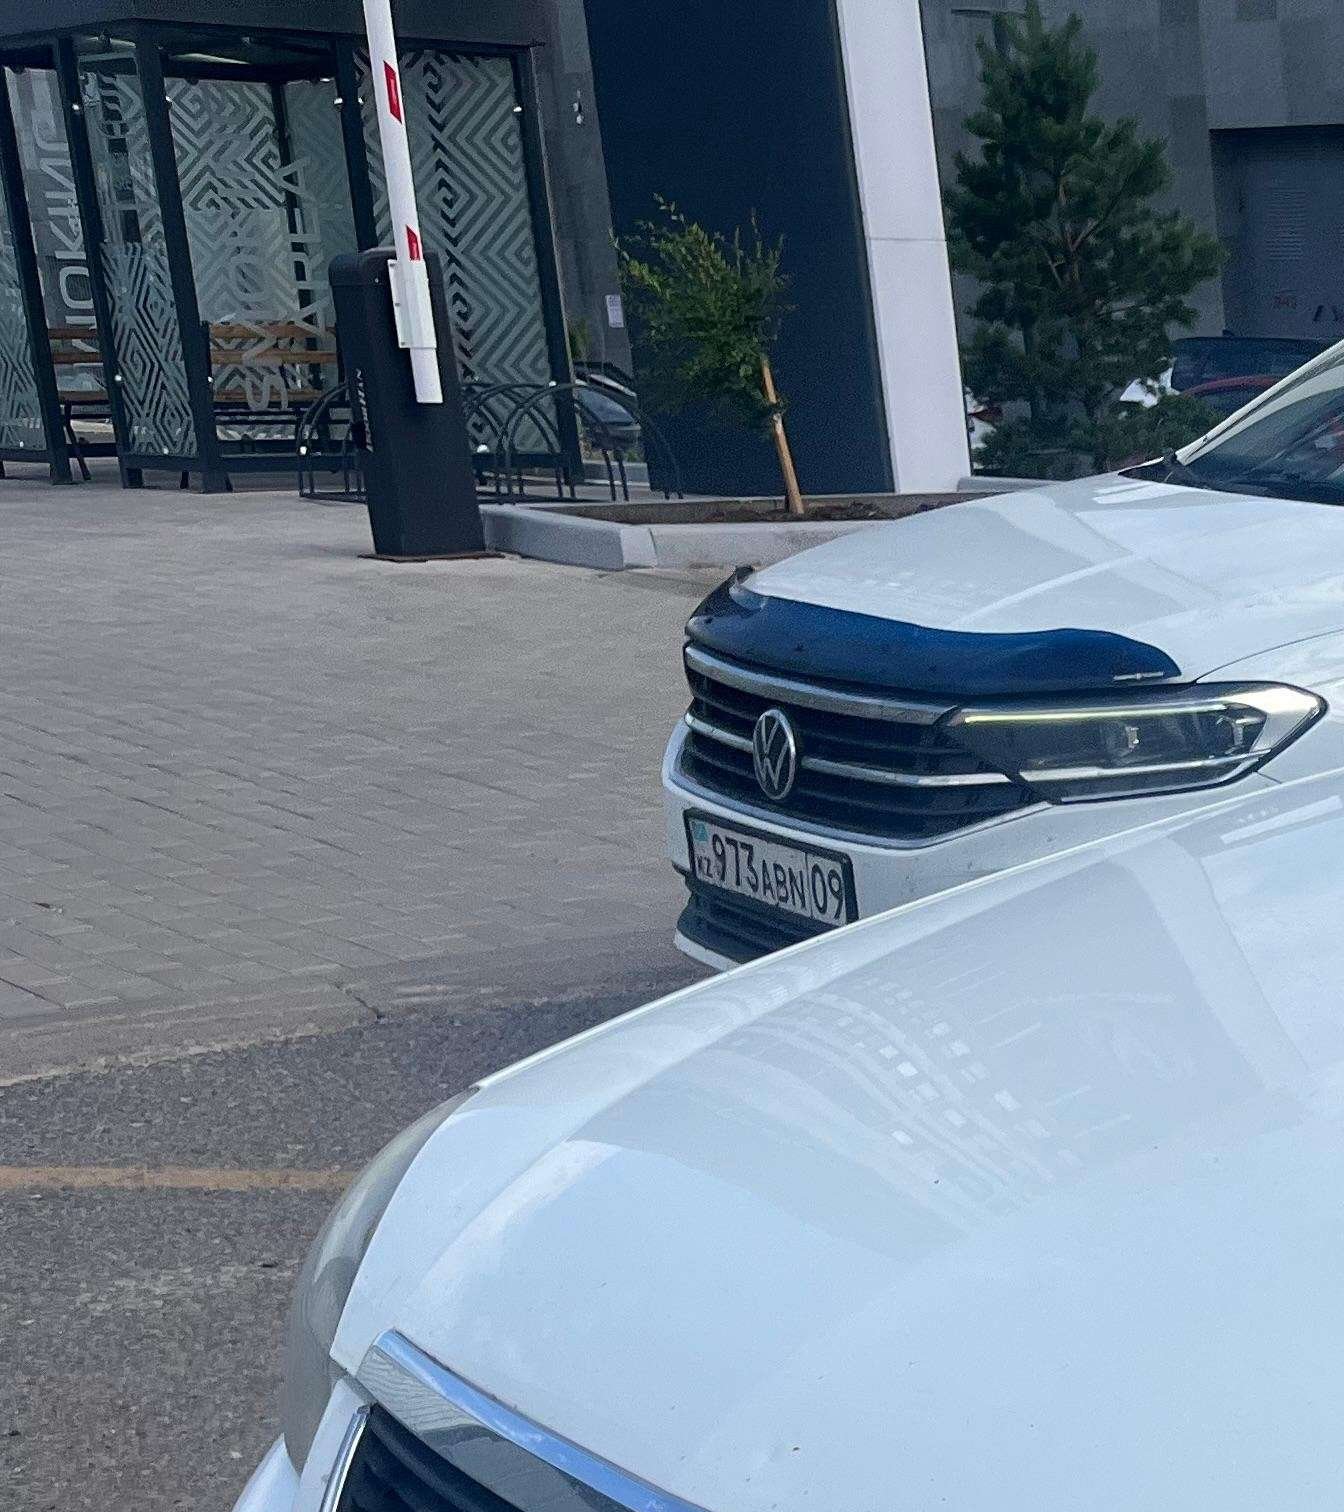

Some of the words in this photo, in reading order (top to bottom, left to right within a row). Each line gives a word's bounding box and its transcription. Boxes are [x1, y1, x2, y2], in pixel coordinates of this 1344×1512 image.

[278, 156, 331, 338] AREA
[711, 833, 807, 908] 973ABN
[811, 863, 843, 919] 09
